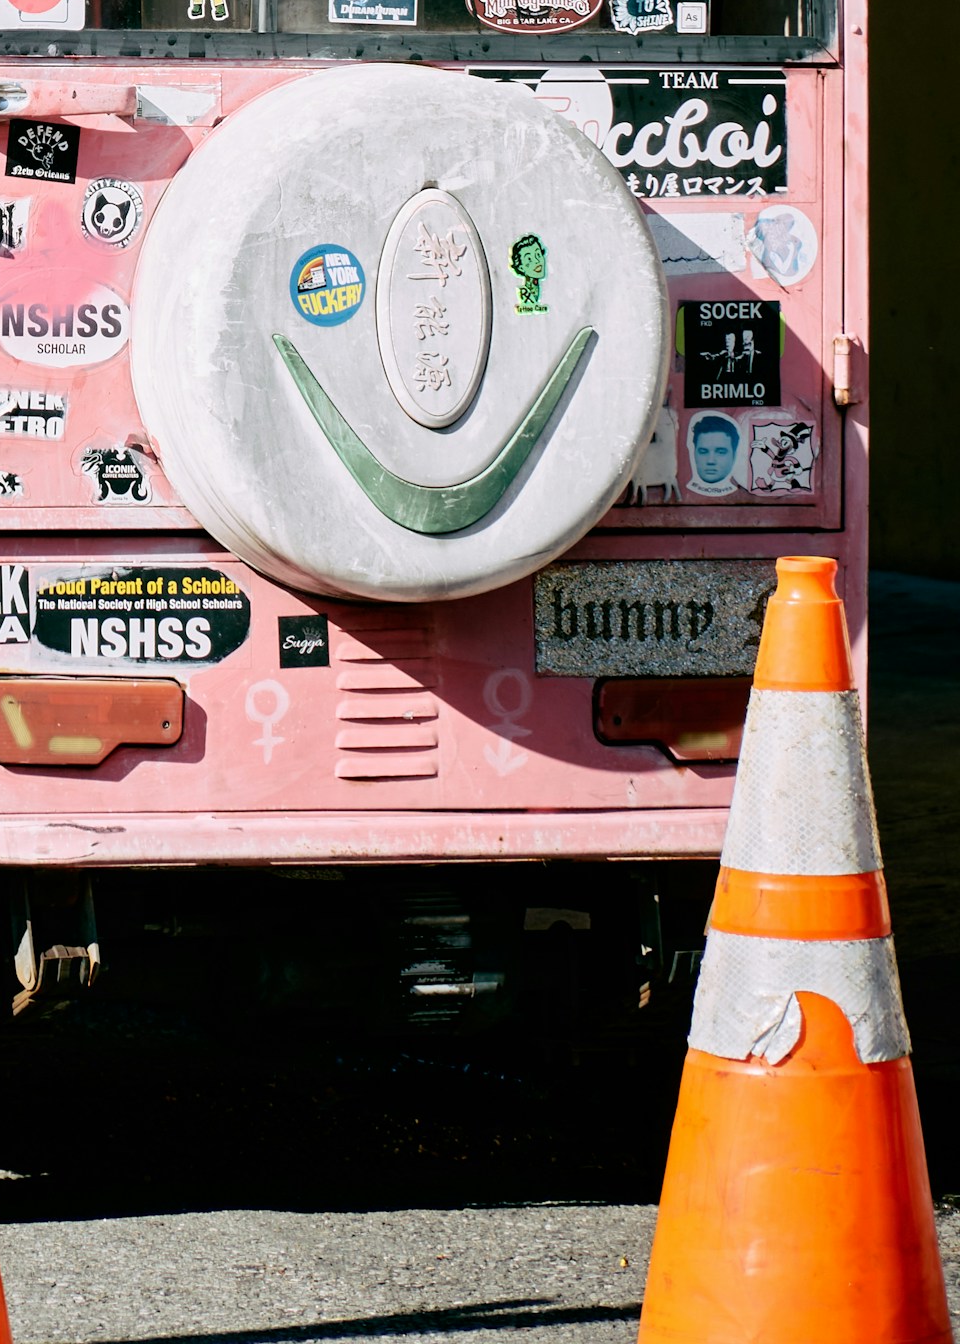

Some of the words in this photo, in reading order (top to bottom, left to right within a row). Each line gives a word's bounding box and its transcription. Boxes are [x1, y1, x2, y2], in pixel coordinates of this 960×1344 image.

[685, 13, 698, 22] As
[659, 72, 719, 89] TEAM
[18, 124, 69, 152] DEFEND
[11, 165, 34, 176] New
[35, 167, 70, 181] Orleans
[324, 252, 351, 267] NEW
[327, 266, 360, 286] YORK
[297, 283, 363, 315] FUCKERY
[700, 302, 763, 319] SOCEK
[1, 303, 122, 338] NSHSS
[37, 343, 86, 354] SCHOLAR
[6, 389, 65, 410] NEK
[701, 383, 766, 399] BRIMLO
[105, 464, 136, 473] ICONIK
[38, 577, 85, 595] Proud
[90, 578, 143, 595] Parent
[146, 577, 164, 595] of
[168, 582, 178, 595] a
[38, 599, 55, 610] The
[57, 599, 96, 610] National
[98, 599, 132, 612] Society
[134, 599, 145, 610] of
[146, 599, 167, 612] High
[169, 599, 201, 610] School
[202, 599, 243, 610] Scholars
[71, 616, 212, 658] NSHSS
